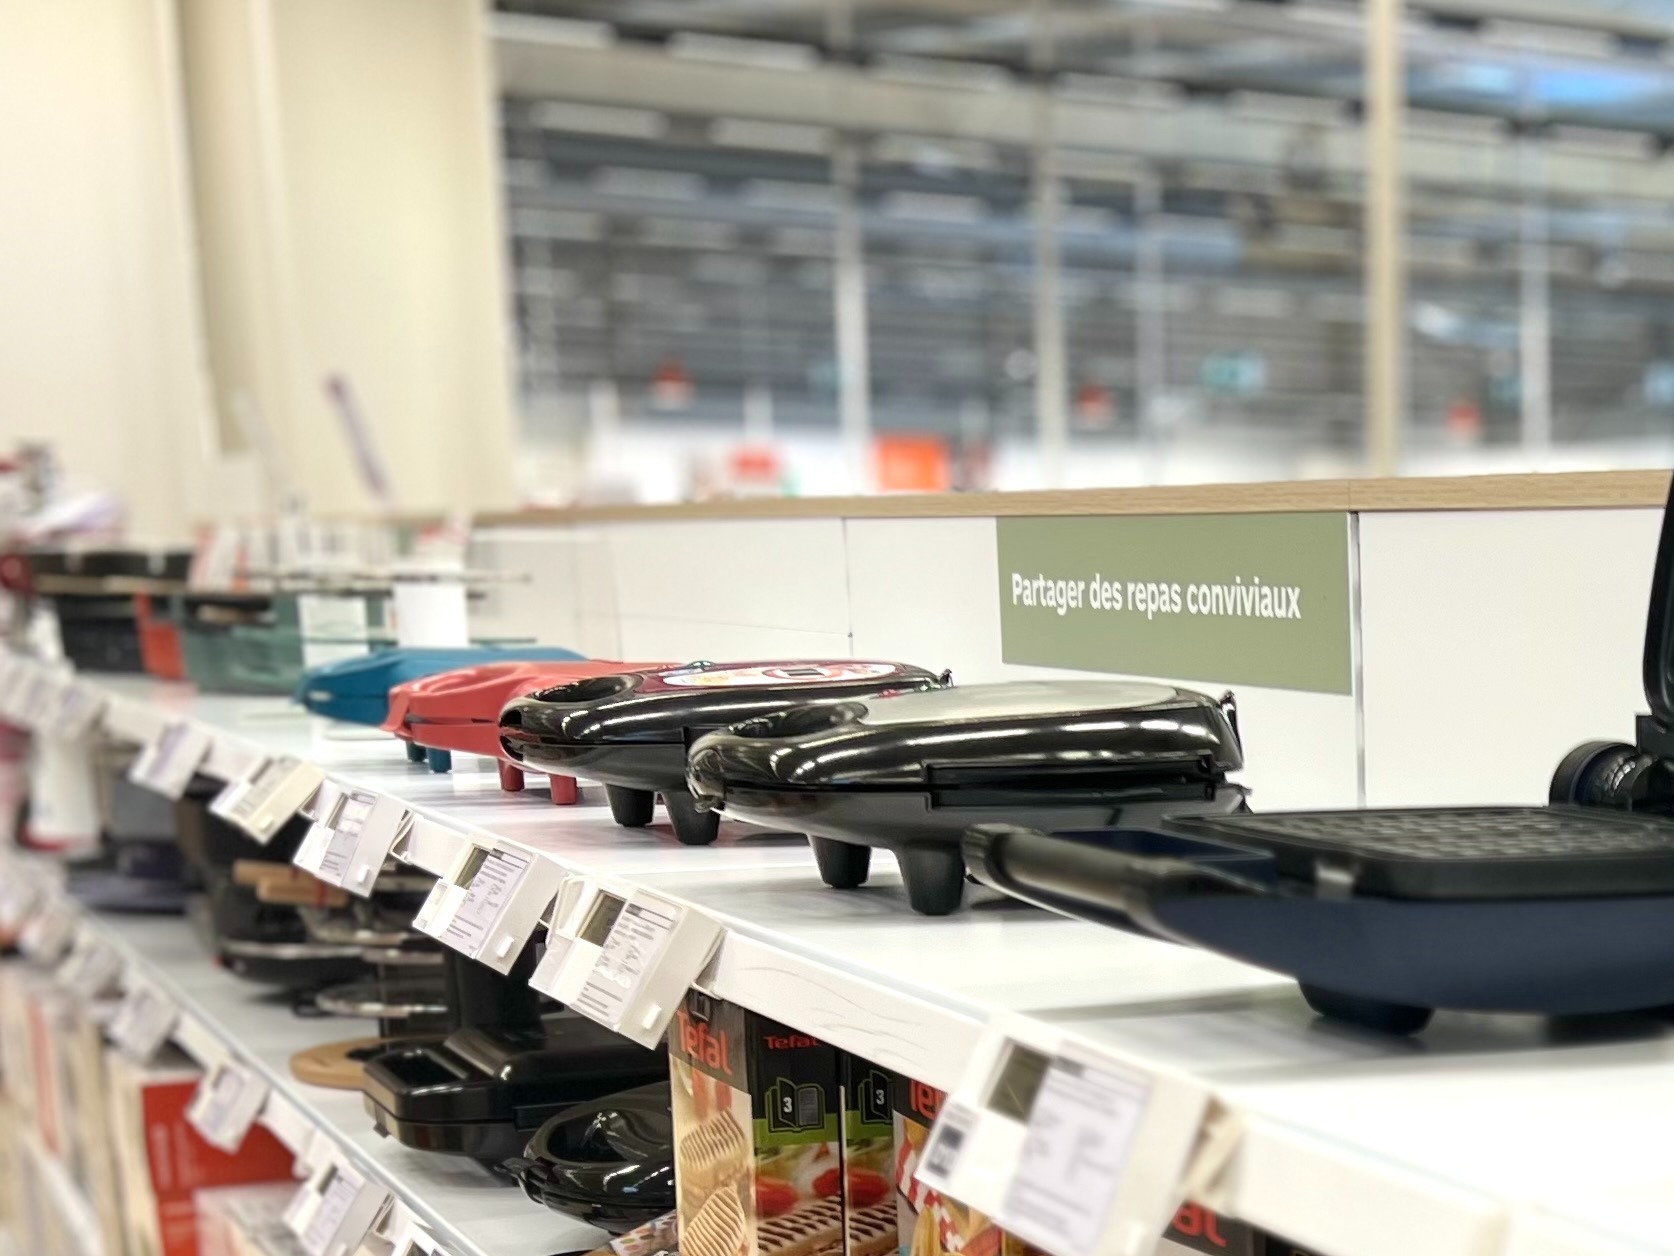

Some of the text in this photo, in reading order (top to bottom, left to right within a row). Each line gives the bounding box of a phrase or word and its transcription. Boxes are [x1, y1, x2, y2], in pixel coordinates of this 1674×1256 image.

[1011, 572, 1302, 620] Partager des repas conviviaux
[676, 1010, 733, 1077] Tefal
[1172, 1201, 1227, 1248] al
